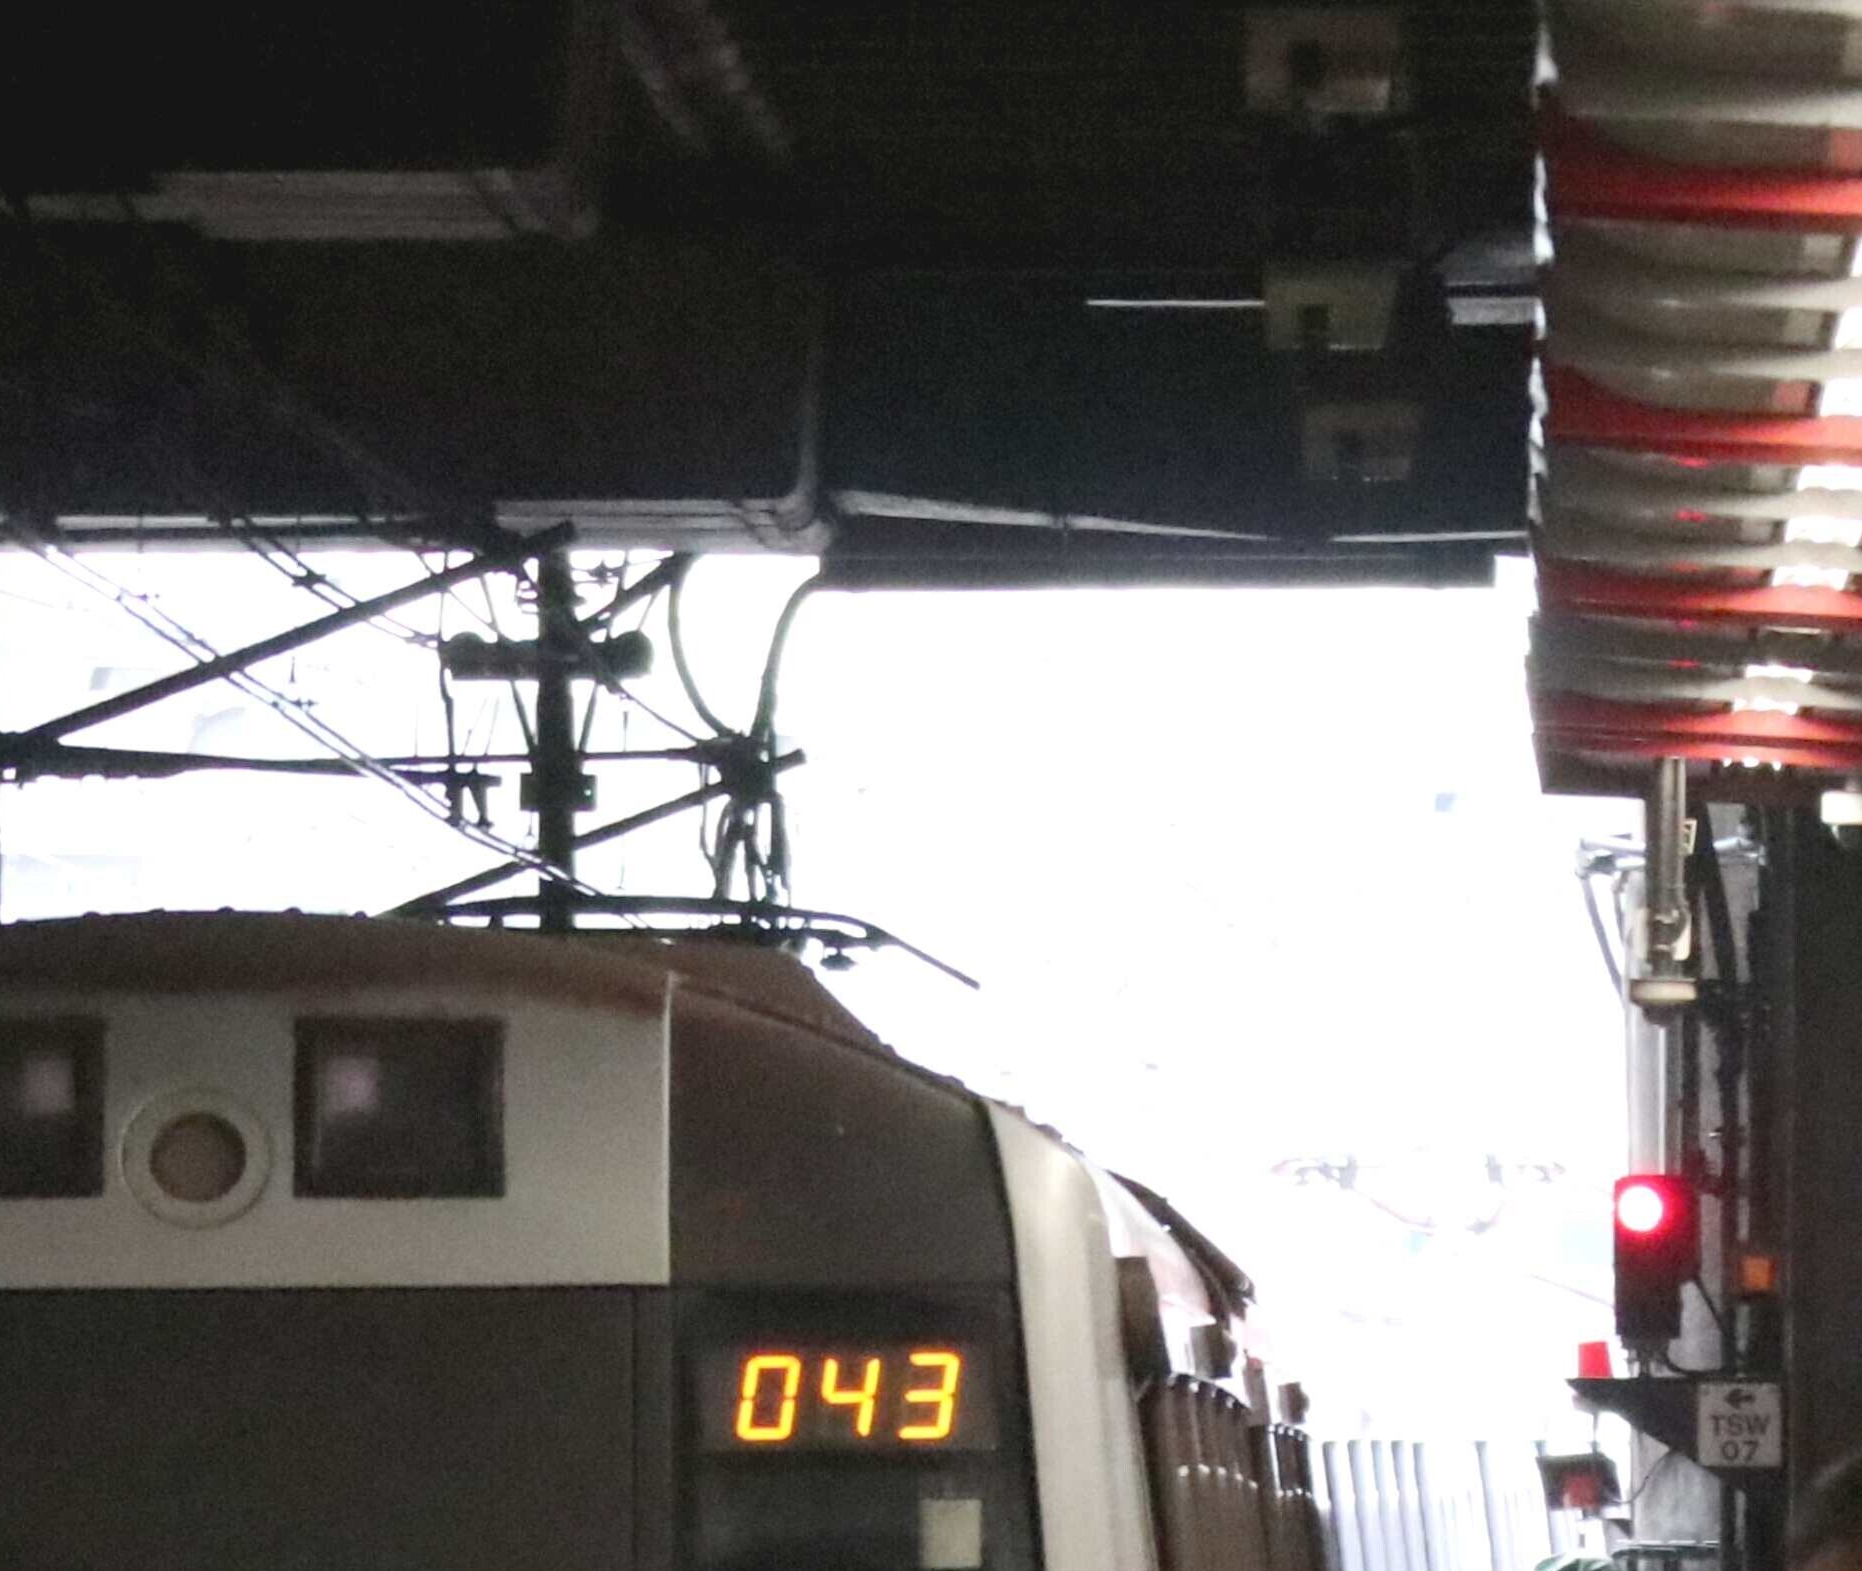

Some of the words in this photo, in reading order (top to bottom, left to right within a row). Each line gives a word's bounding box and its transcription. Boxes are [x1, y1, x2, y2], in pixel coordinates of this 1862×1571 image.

[735, 1350, 962, 1442] 043
[1709, 1413, 1771, 1436] TSW
[1720, 1440, 1760, 1461] 07
